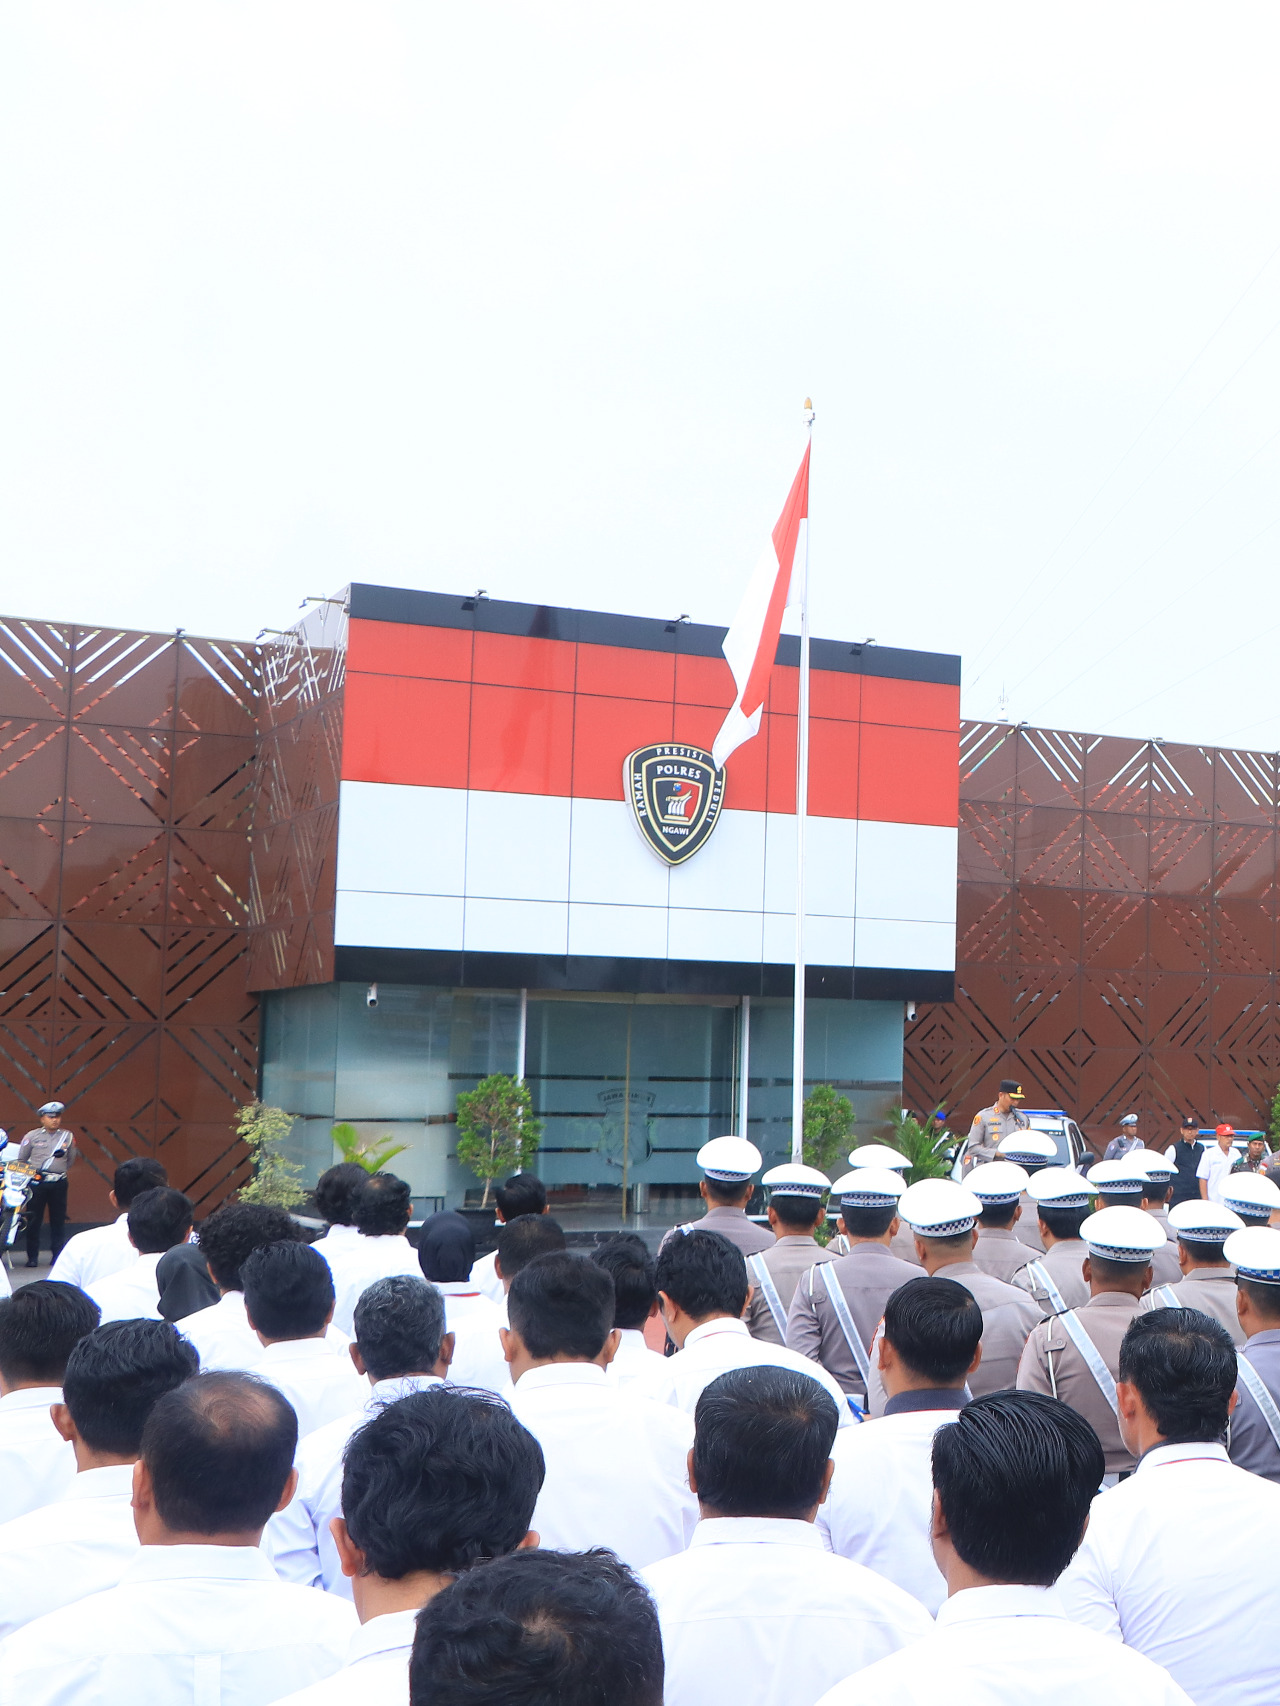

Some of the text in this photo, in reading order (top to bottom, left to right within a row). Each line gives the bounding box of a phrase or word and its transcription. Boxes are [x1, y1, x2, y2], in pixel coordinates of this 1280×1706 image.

[656, 747, 703, 761] PRESISI
[656, 765, 702, 779] POLRES
[634, 773, 647, 817] RAMAH
[706, 780, 722, 823] PEDULI
[662, 825, 690, 836] NGAWI
